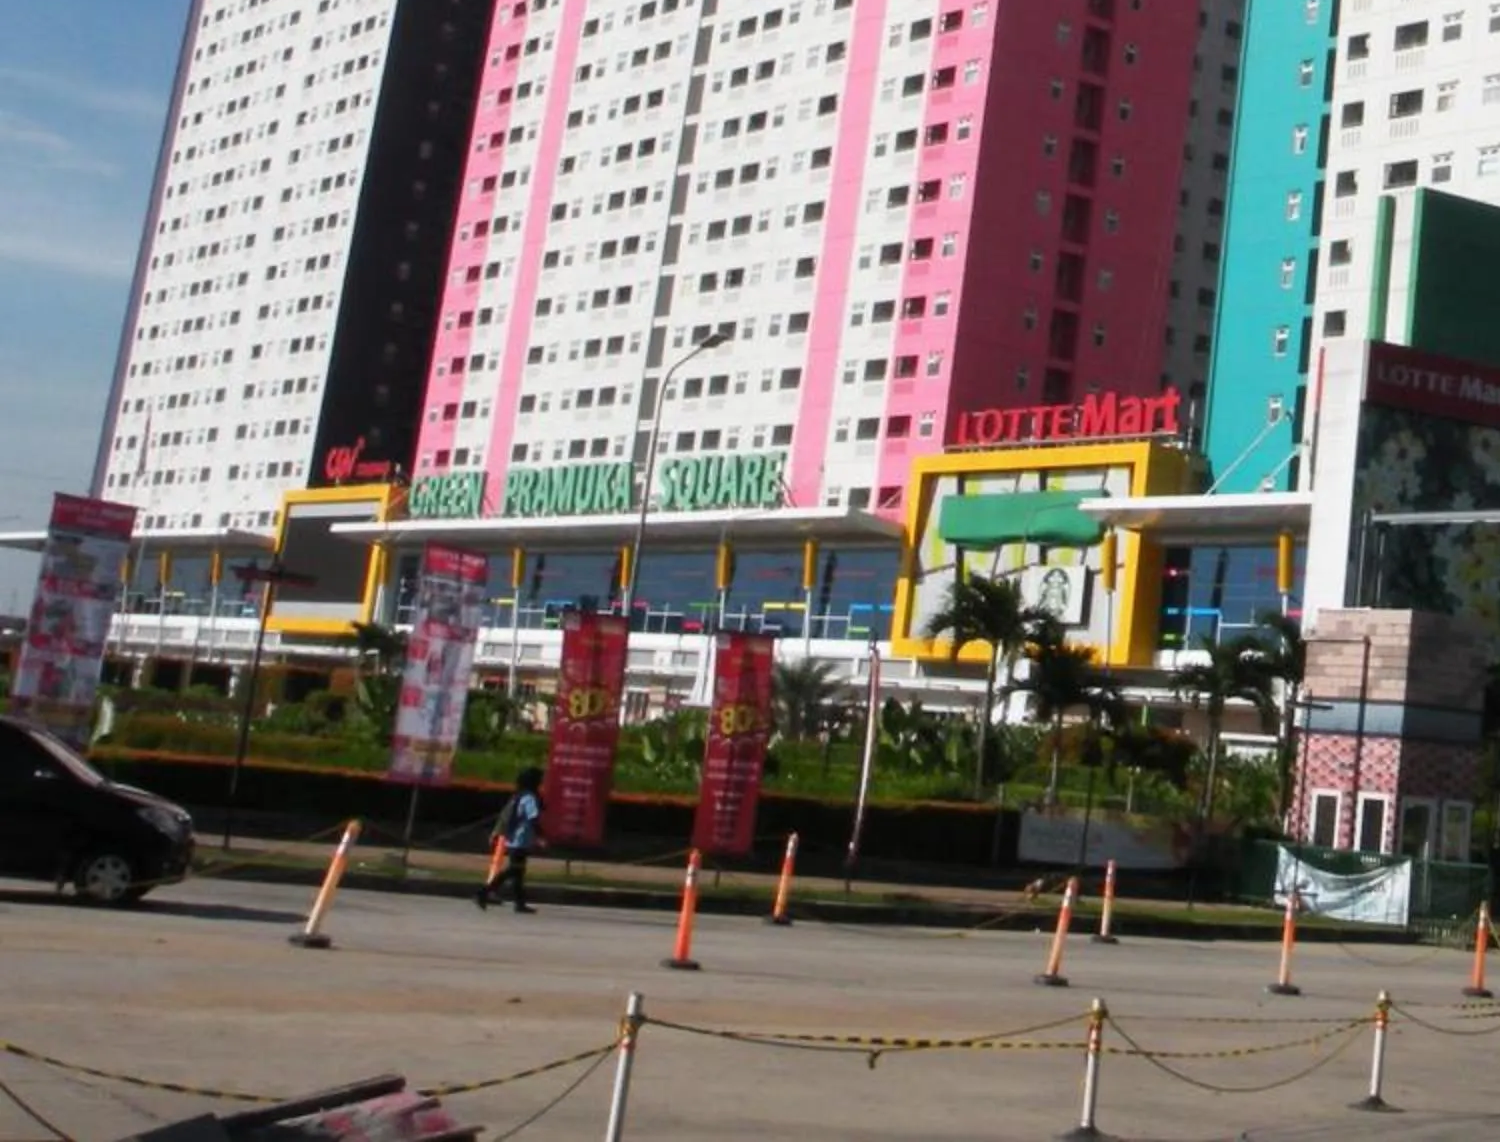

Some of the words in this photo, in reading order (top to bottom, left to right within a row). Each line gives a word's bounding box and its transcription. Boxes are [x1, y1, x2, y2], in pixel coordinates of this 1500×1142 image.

[1375, 362, 1455, 396] LOTTE
[956, 404, 1074, 446] LOTTE
[1079, 385, 1181, 435] Mart
[408, 471, 487, 517] GREEN
[502, 461, 636, 517] PRAMUKA
[657, 451, 788, 510] SQUARE
